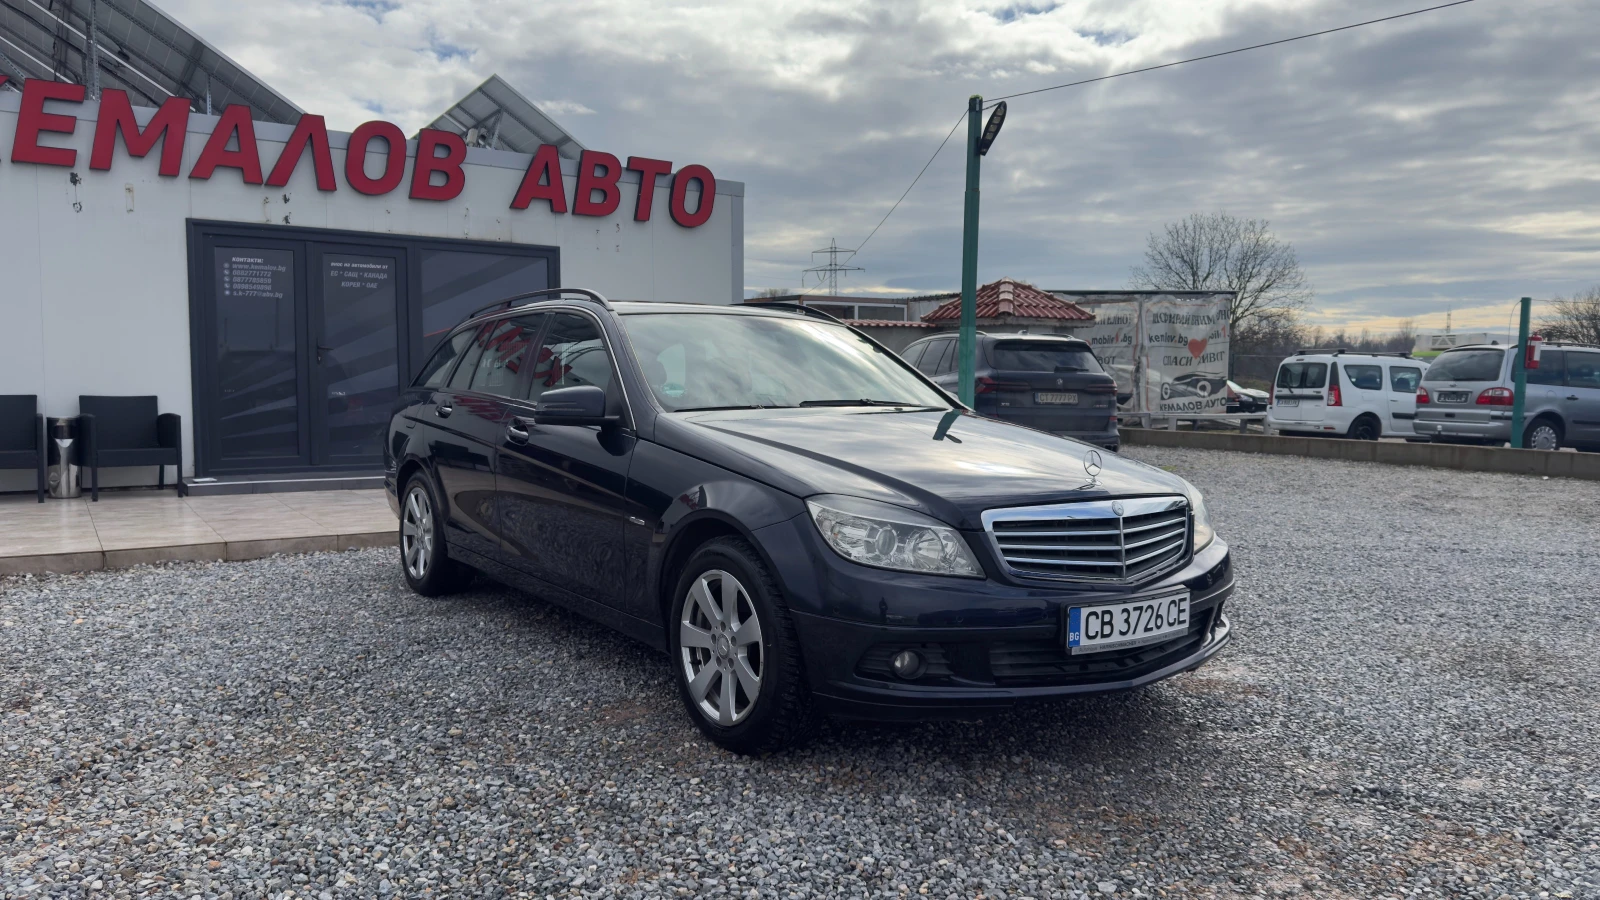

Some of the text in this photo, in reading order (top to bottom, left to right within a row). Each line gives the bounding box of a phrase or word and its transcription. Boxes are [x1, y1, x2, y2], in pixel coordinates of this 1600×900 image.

[0, 74, 718, 229] ЕМАЛОВ АВТО
[1069, 632, 1080, 642] BG
[1085, 609, 1114, 640] CB
[1119, 602, 1164, 636] 3726
[1166, 596, 1188, 627] CE
